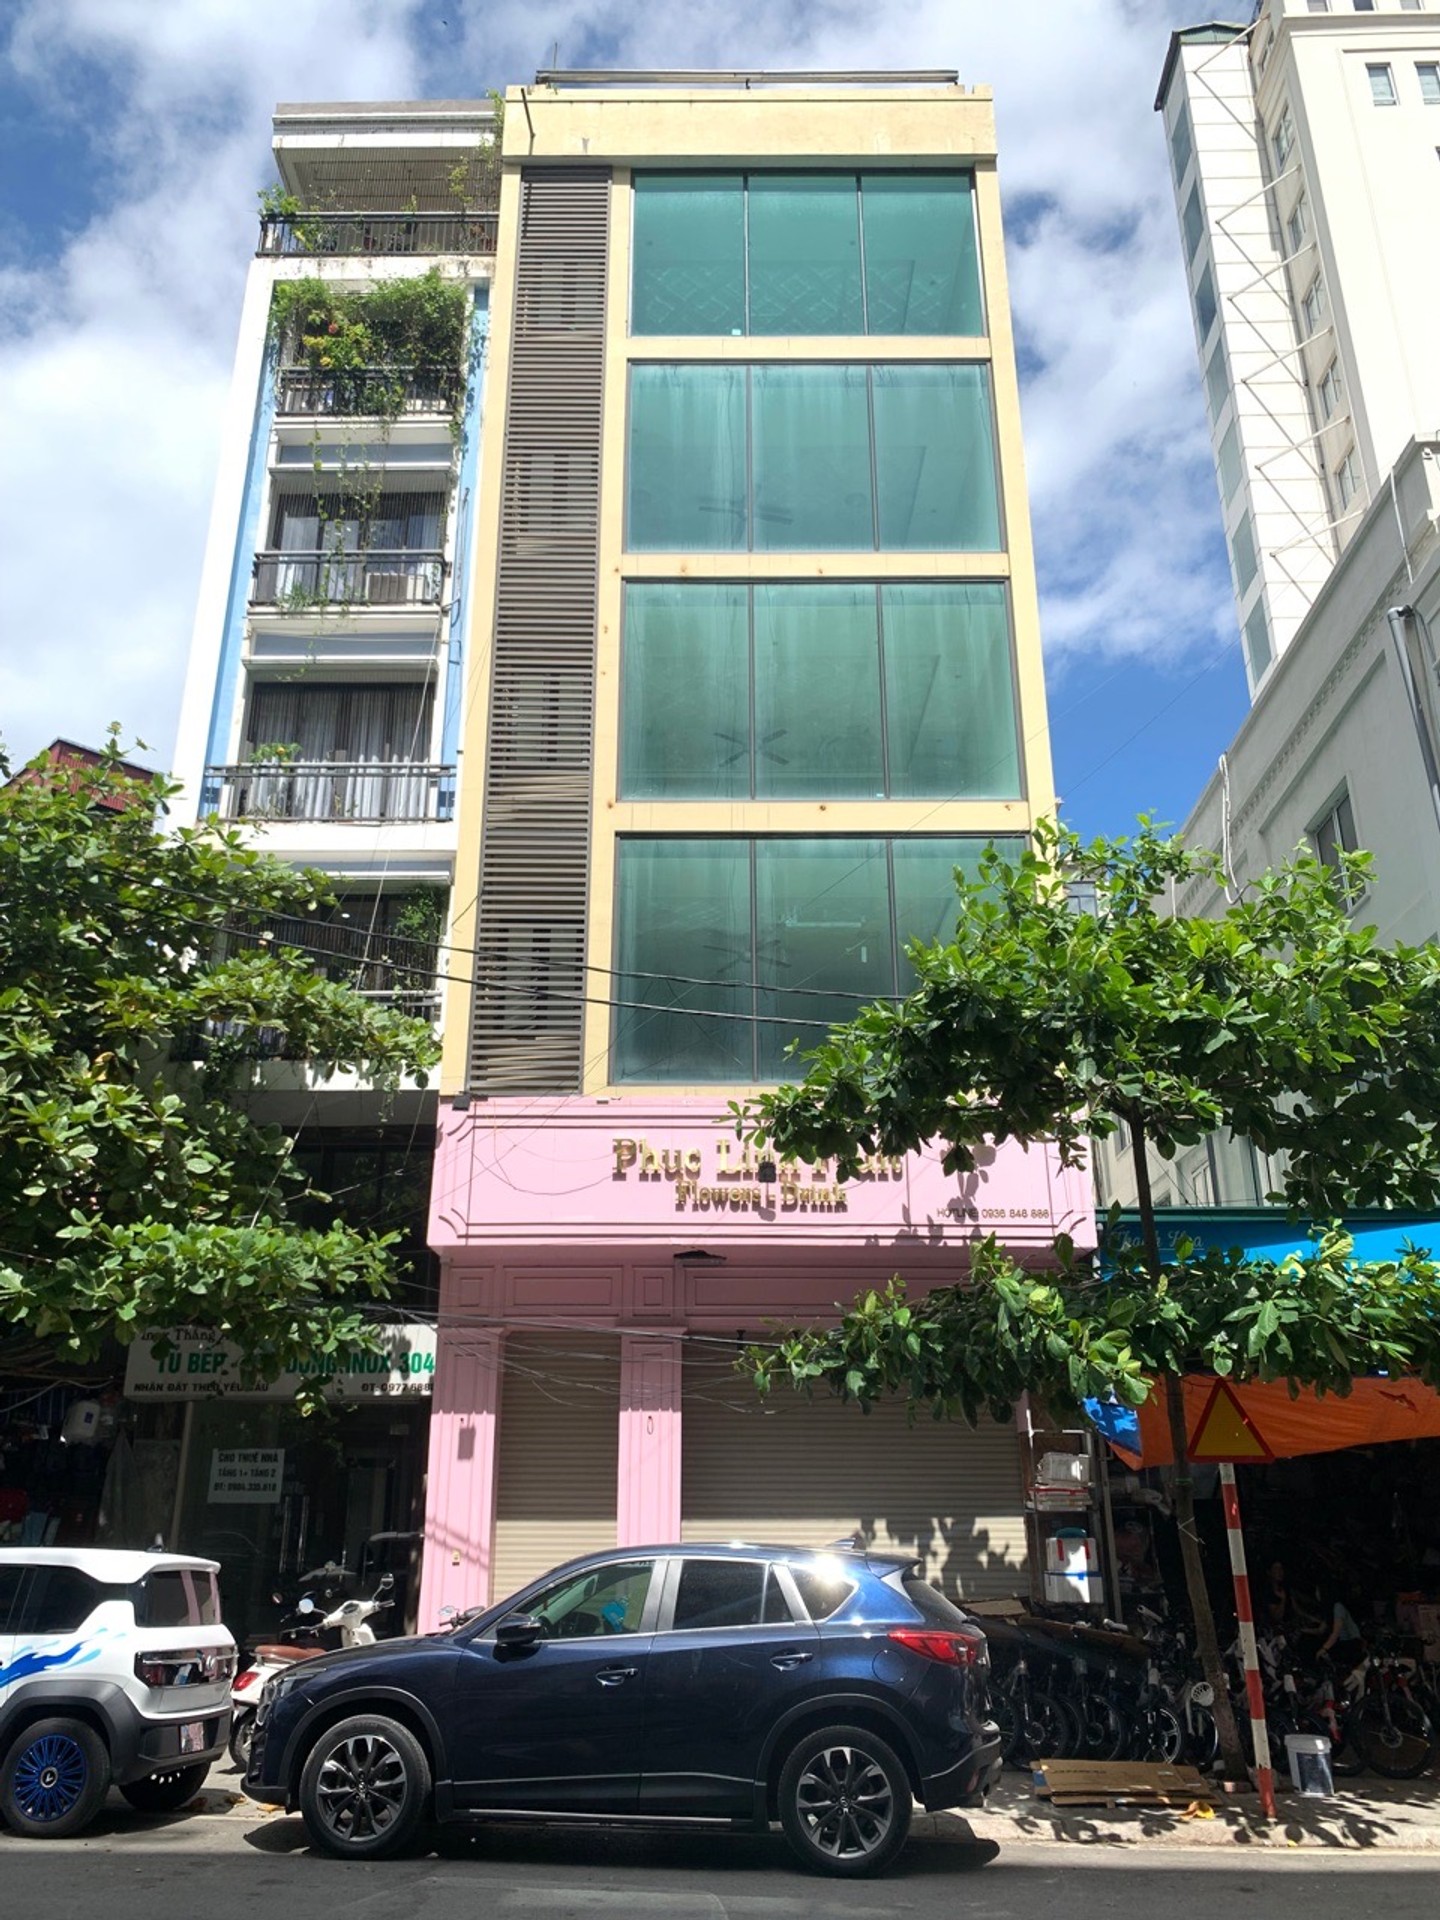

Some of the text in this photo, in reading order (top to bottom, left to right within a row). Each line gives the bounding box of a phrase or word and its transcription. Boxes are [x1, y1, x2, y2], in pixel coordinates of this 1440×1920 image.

[675, 1180, 761, 1209] Flowers
[780, 1180, 848, 1209] Drink
[398, 1351, 434, 1374] 304
